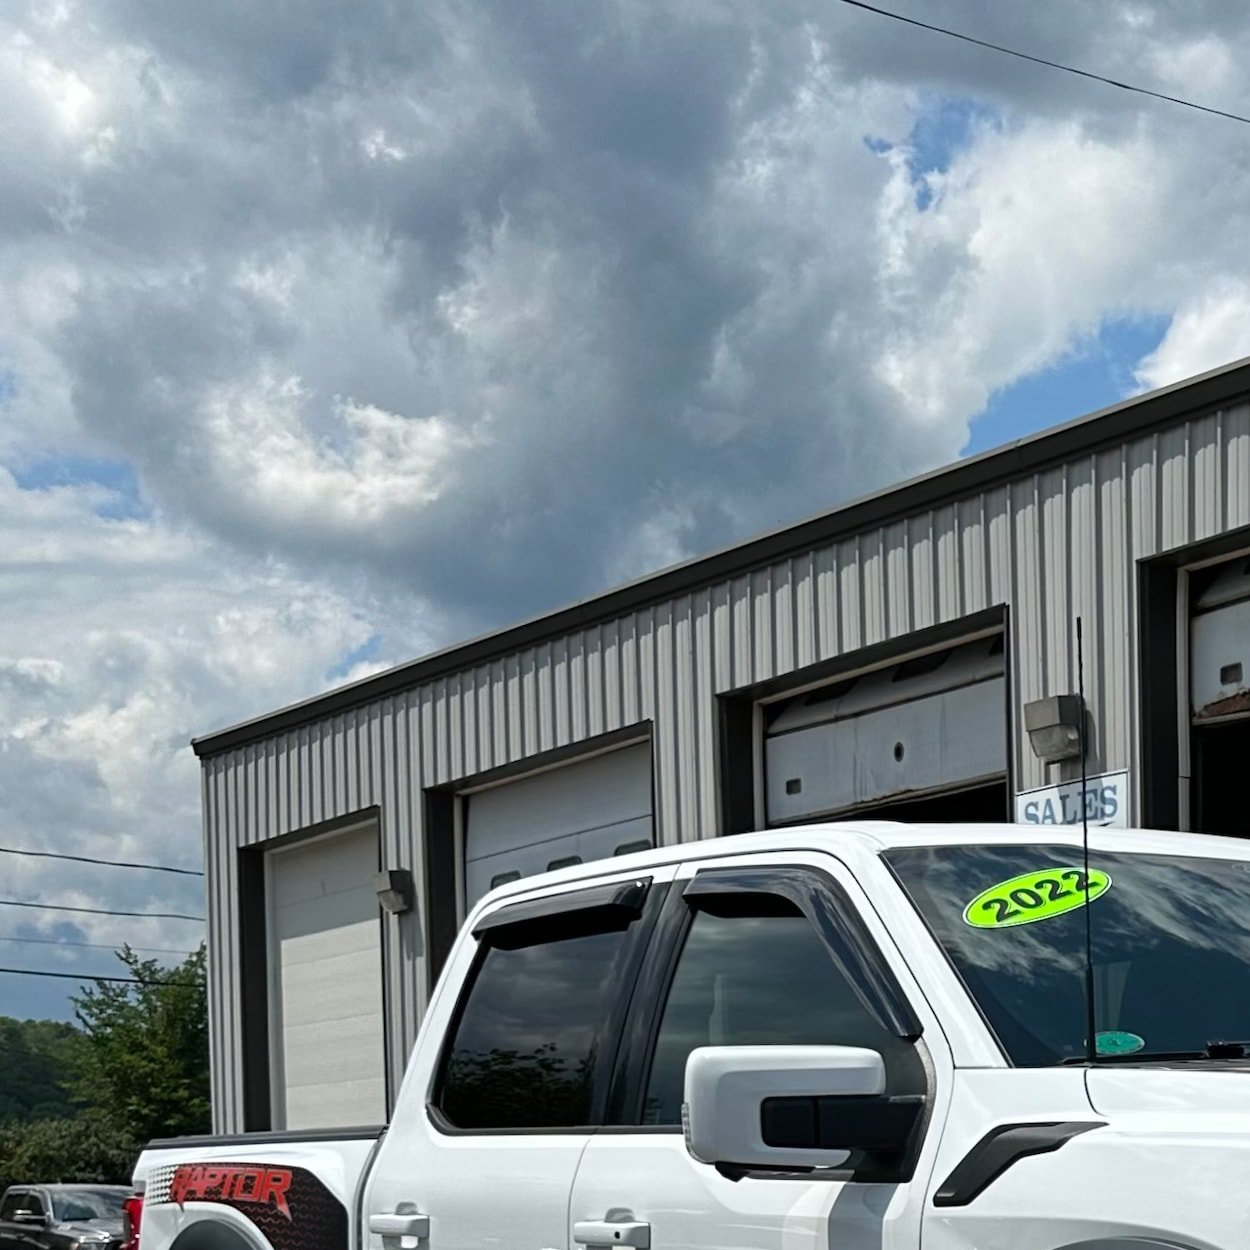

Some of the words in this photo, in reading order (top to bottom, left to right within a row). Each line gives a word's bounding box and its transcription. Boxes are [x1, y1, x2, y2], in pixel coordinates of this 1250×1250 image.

[1024, 784, 1118, 824] SALES
[981, 870, 1103, 923] 2022
[171, 1164, 294, 1222] RAPTOR
